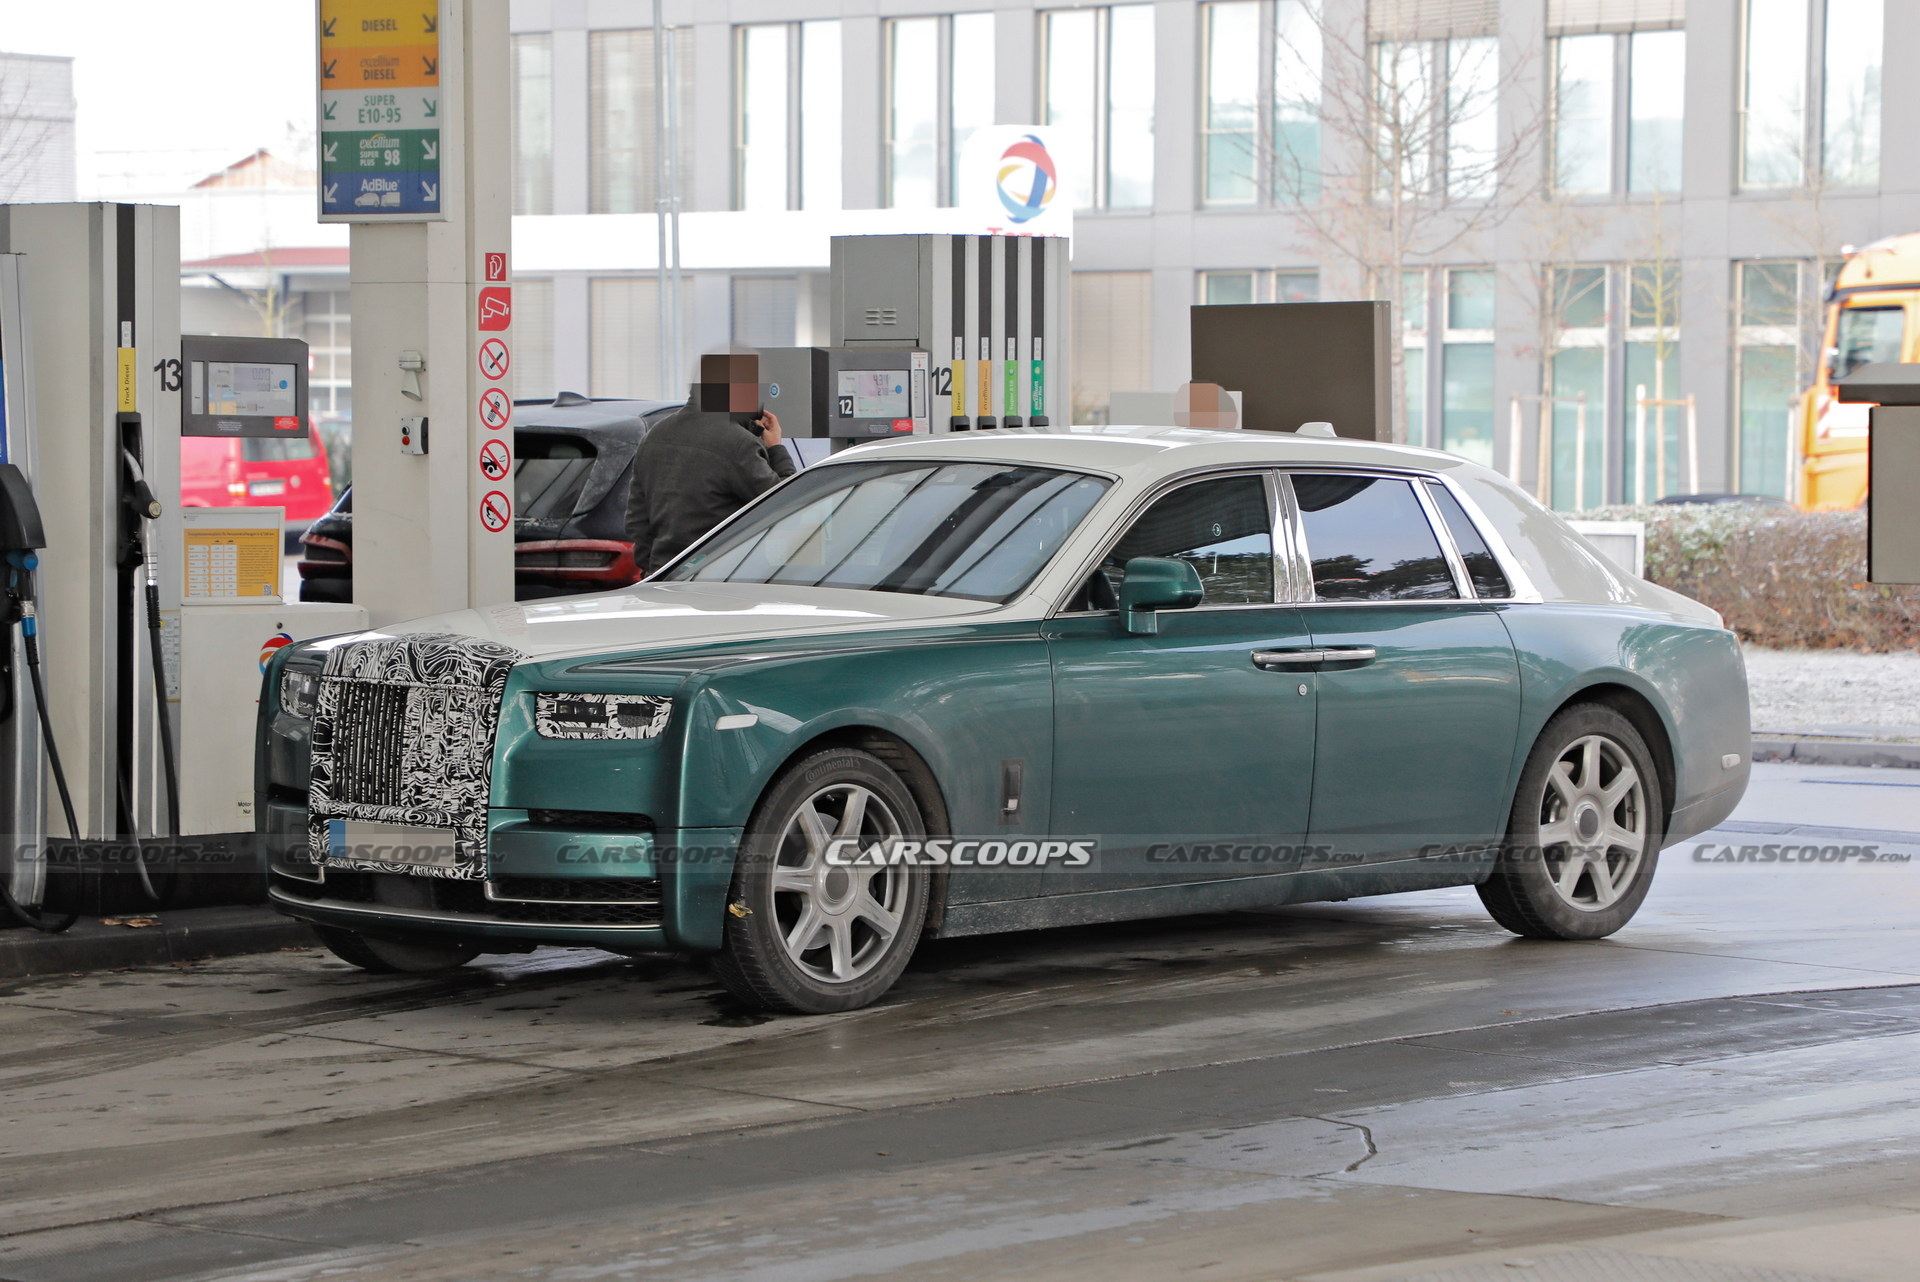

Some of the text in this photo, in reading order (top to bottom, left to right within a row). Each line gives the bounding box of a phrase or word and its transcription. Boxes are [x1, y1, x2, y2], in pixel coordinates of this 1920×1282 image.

[361, 19, 398, 32] DIESEL
[360, 55, 399, 68] excellium
[363, 69, 396, 81] DIESEL
[364, 95, 396, 106] SUPER
[358, 107, 401, 124] E10-95
[359, 136, 400, 150] excellium
[360, 151, 379, 159] SUPER
[384, 149, 400, 166] 98
[360, 159, 375, 167] PLUS
[154, 358, 181, 392] 13
[931, 366, 952, 396] 12
[839, 399, 853, 415] 12
[805, 757, 854, 784] Continental
